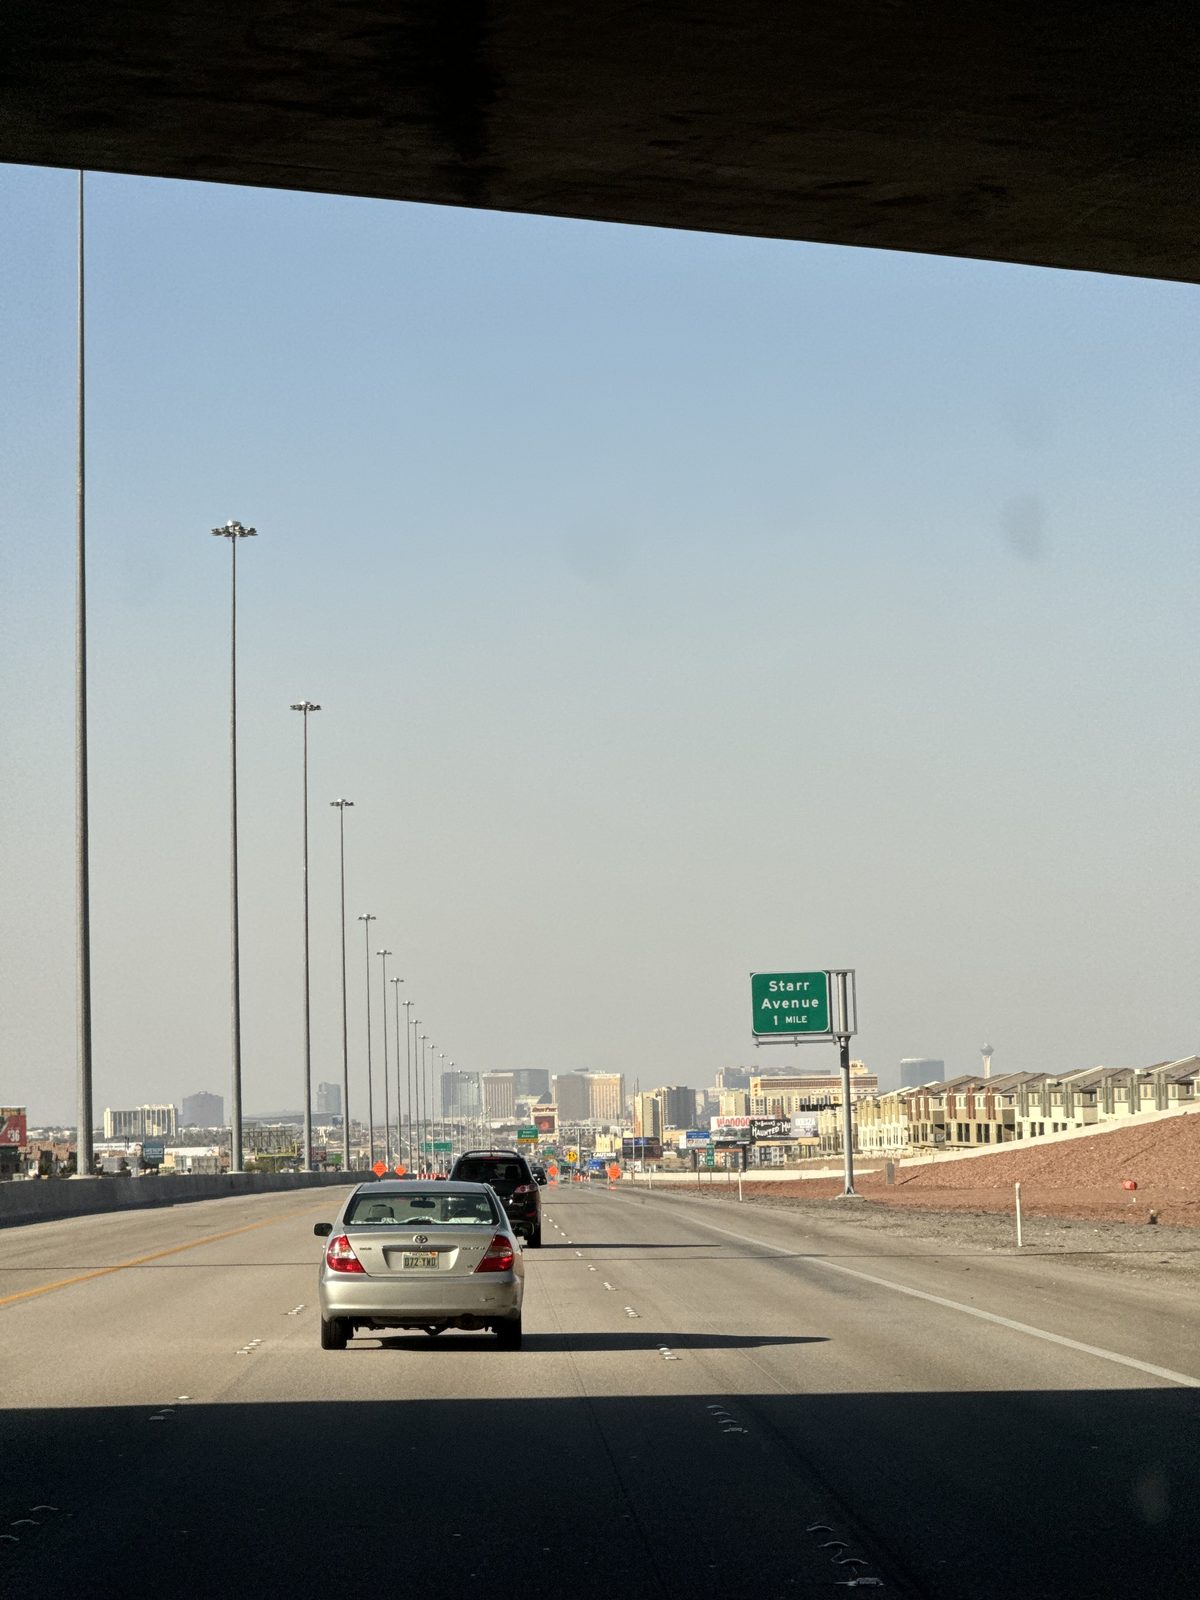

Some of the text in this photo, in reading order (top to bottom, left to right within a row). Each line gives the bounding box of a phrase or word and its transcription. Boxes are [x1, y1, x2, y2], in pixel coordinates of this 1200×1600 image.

[769, 981, 810, 992] Starr
[761, 999, 819, 1009] Avenue
[773, 1015, 778, 1025] 1
[751, 1124, 779, 1139] HAUNTED
